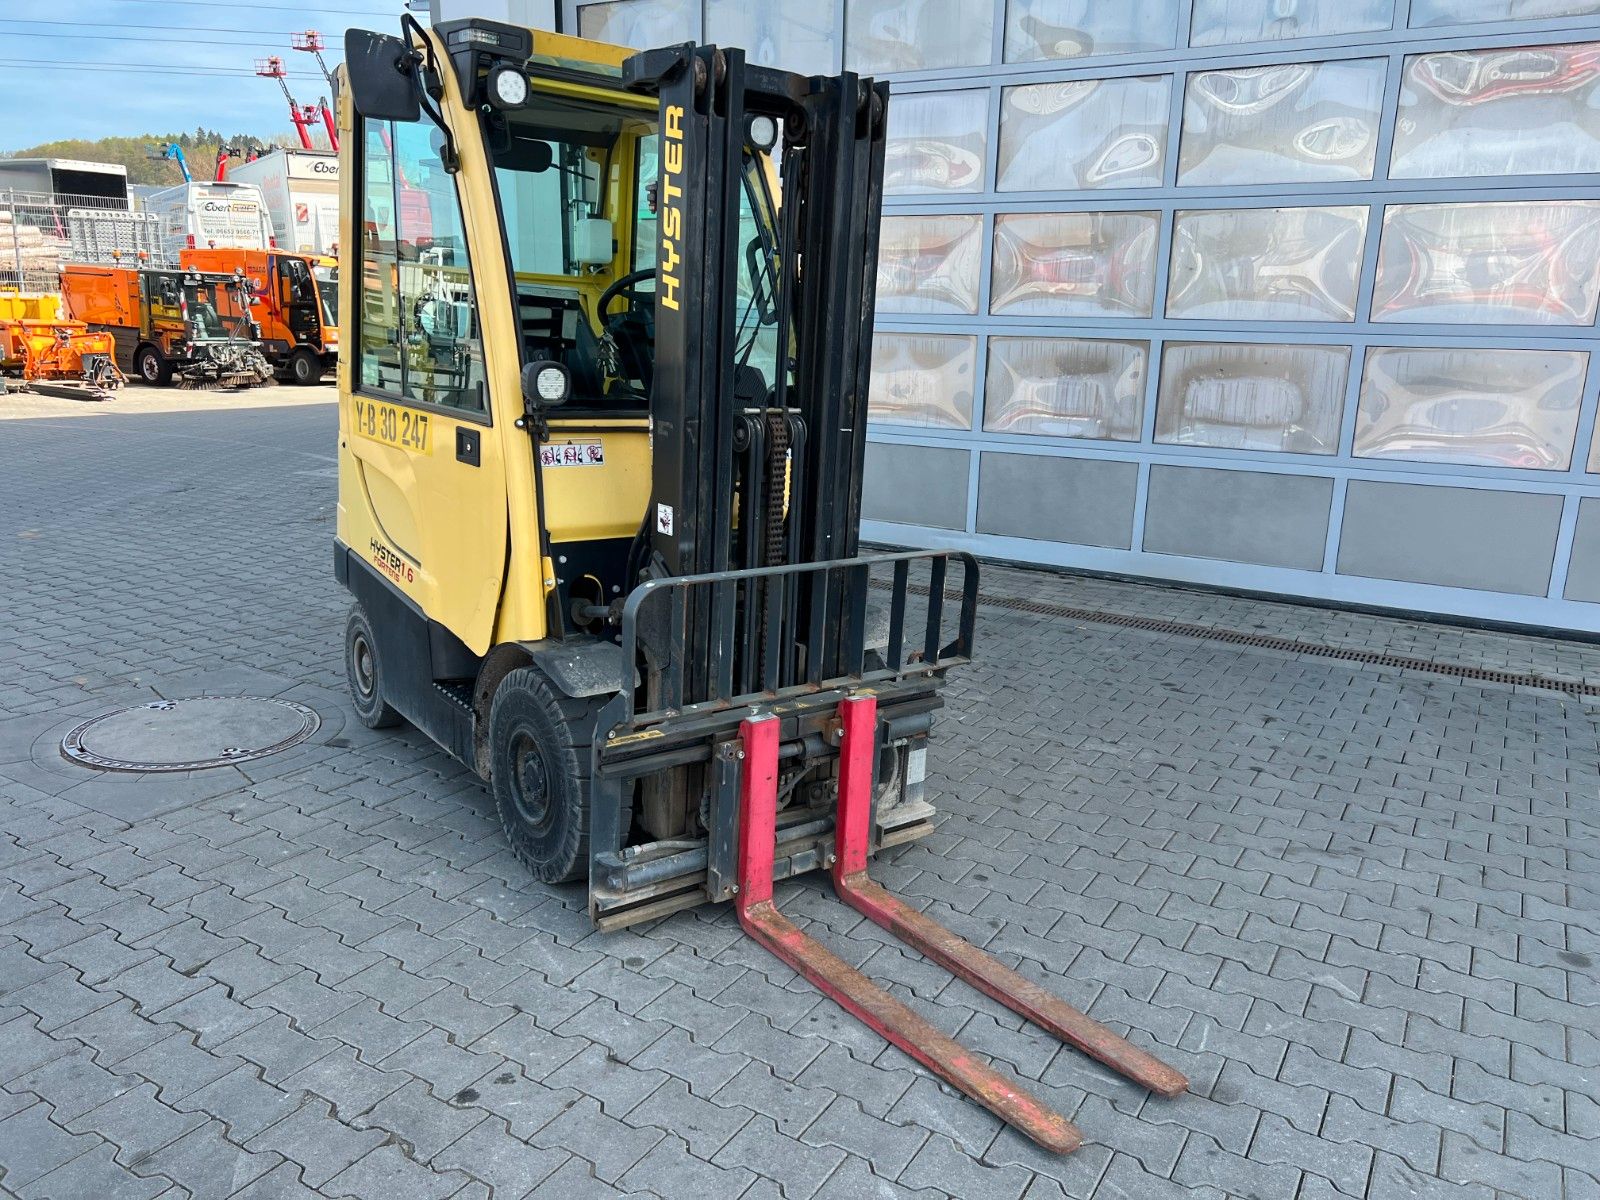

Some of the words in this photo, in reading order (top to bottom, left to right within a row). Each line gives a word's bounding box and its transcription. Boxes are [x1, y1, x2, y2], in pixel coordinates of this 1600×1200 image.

[204, 201, 231, 212] Ebert
[661, 105, 684, 311] HYSTER
[356, 400, 376, 436] Y-B
[380, 406, 397, 442] 30
[402, 411, 428, 451] 247
[370, 537, 401, 573] HYSTER
[401, 562, 413, 583] 1.6
